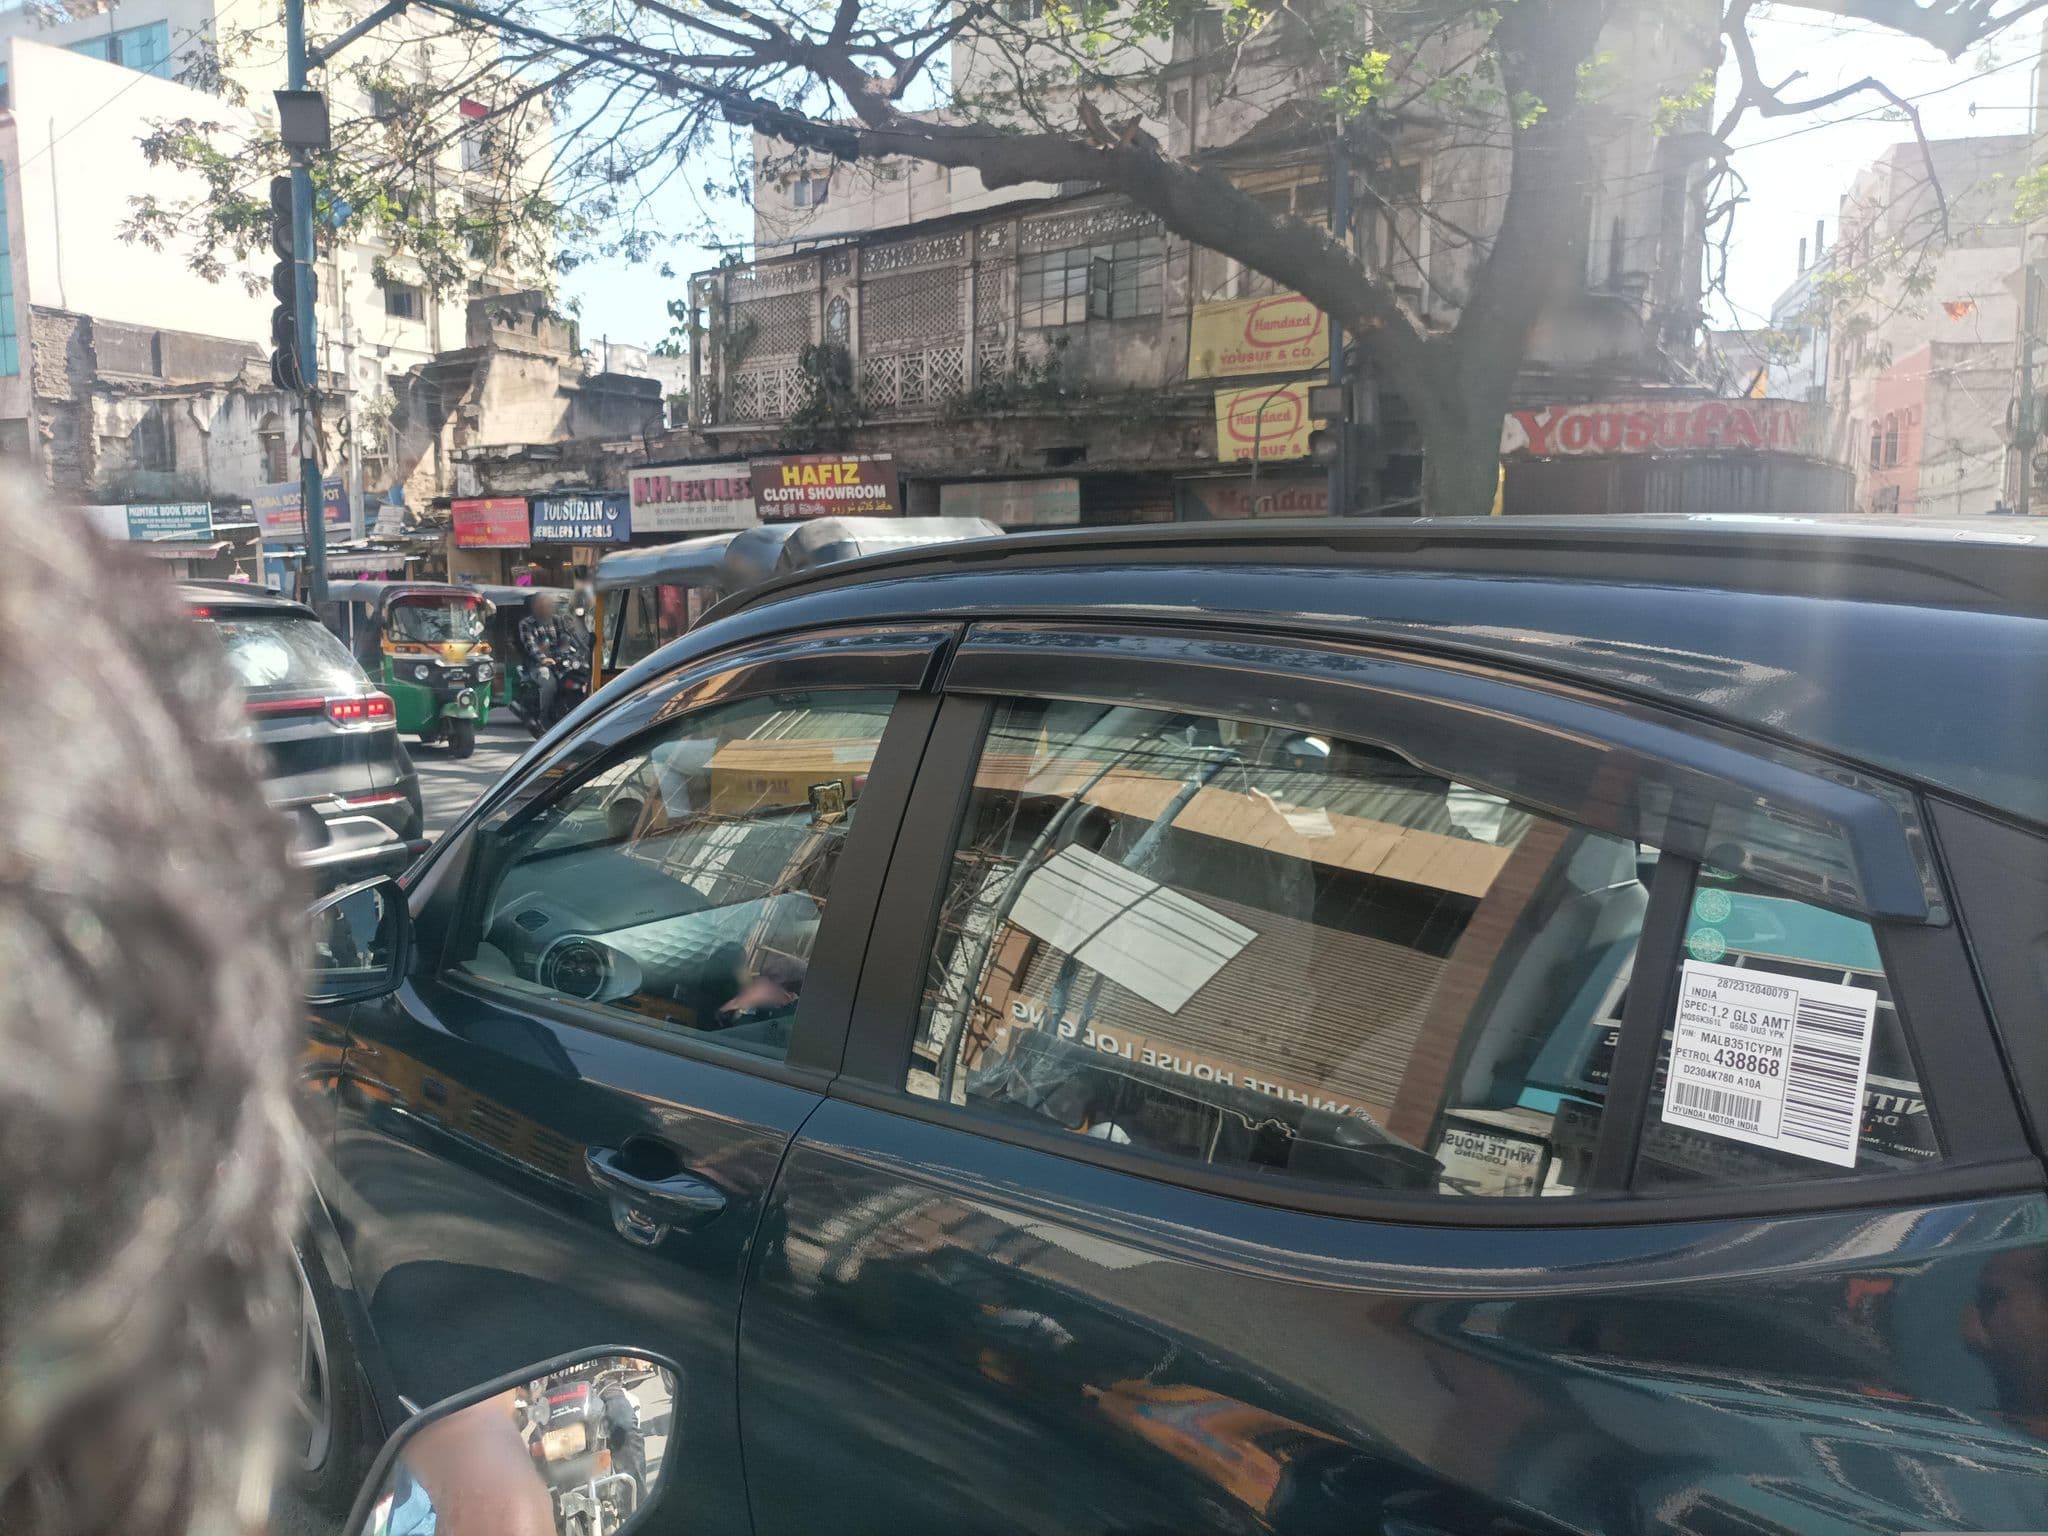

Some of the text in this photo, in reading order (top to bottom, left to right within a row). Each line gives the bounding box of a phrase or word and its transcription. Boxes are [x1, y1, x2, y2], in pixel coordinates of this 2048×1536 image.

[1220, 347, 1314, 365] YOUSUF & CO.
[782, 463, 860, 486] HAFIZ
[763, 484, 887, 501] CLOTH SHOWROOM
[543, 501, 604, 521] YOUSUFAIN
[582, 524, 613, 537] PEARLS
[1691, 987, 1717, 999] INDIA
[1717, 979, 1790, 999] 2872312040079
[1711, 1005, 1729, 1019] 1.2
[1733, 1009, 1758, 1024] GLS
[1761, 1015, 1790, 1031] AMT
[1769, 1028, 1784, 1038] YPK
[1700, 1032, 1782, 1058] MALB351CYPM
[1675, 1047, 1780, 1077] PETROL 438868
[1683, 1064, 1761, 1090] D2304K780 A10A
[1672, 1105, 1759, 1131] HYUNDAI MOTOR INDIA
